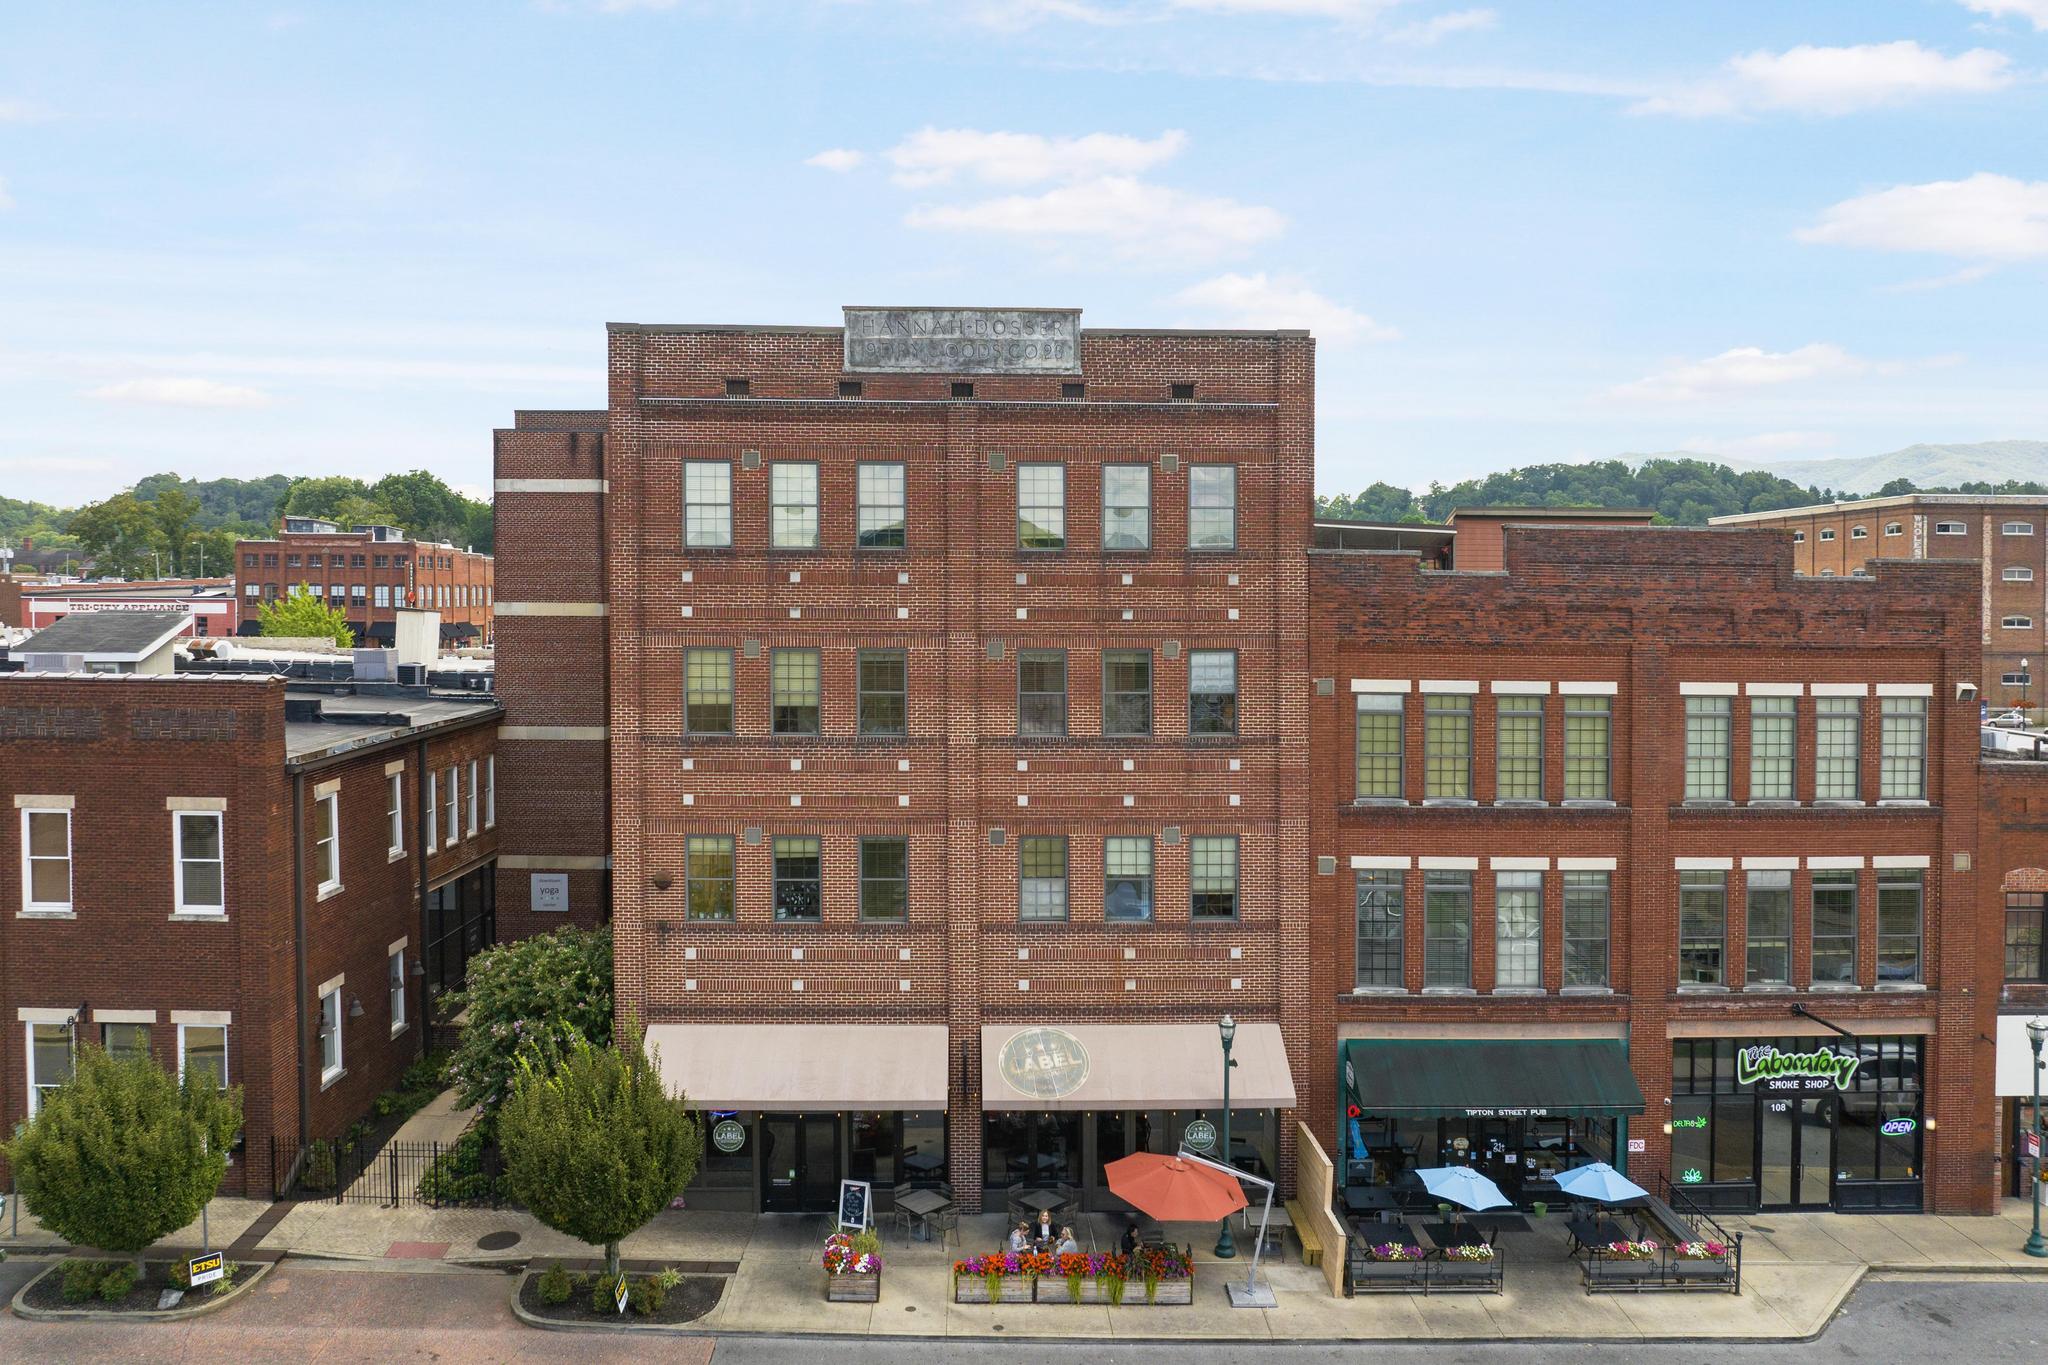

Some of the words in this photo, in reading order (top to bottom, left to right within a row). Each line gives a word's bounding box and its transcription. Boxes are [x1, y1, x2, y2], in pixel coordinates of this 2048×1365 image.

[861, 319, 1064, 336] HANNAH-DOSSER
[1008, 343, 1037, 359] CO
[1914, 515, 1922, 559] WHOLES
[540, 887, 559, 895] yoga
[1011, 1049, 1083, 1075] LABEL
[1738, 1047, 1859, 1090] Laboratory
[1769, 1080, 1800, 1090] SMOKE
[1805, 1080, 1830, 1089] SHOP
[1770, 1104, 1786, 1112] 108
[1884, 1122, 1912, 1132] OPEN
[715, 1132, 743, 1140] LABEL
[1629, 1141, 1644, 1149] FDC
[192, 1258, 220, 1273] ETSU
